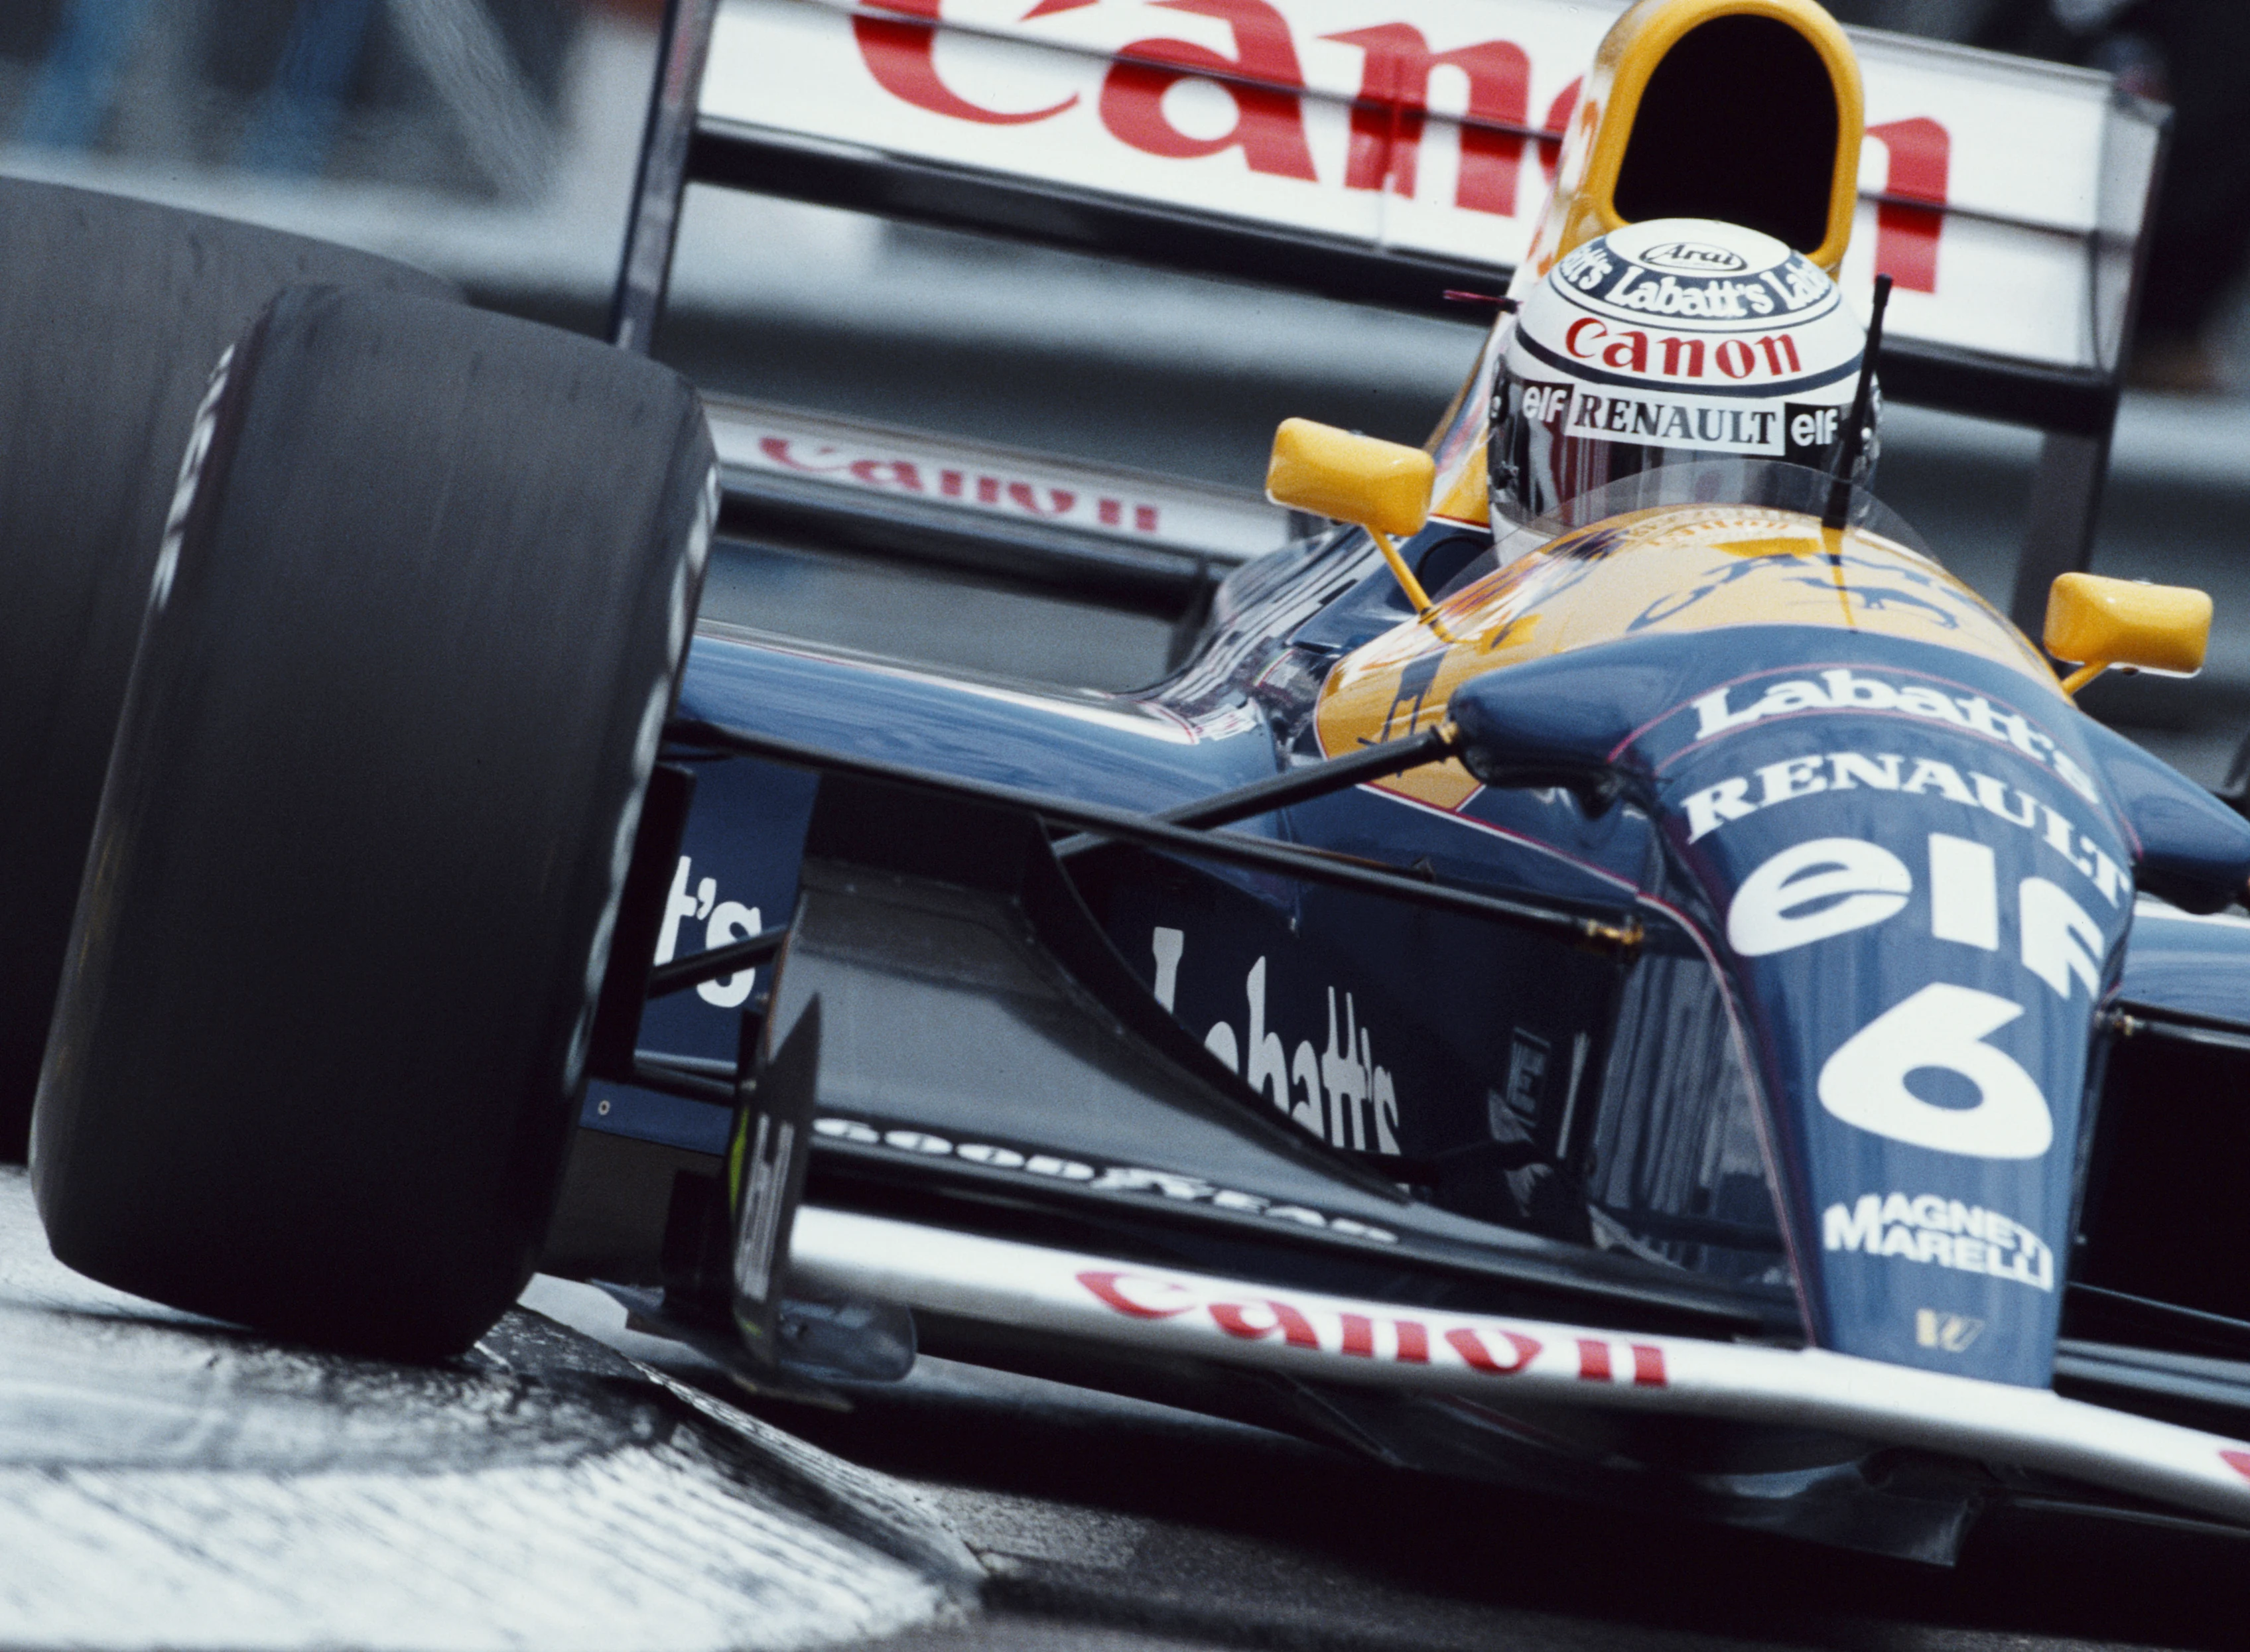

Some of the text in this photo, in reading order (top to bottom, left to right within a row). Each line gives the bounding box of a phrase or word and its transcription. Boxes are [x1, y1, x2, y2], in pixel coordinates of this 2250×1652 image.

[850, 0, 1950, 294] Cann
[1605, 265, 1774, 320] Labatt's
[1646, 243, 1733, 266] Arai
[1565, 317, 1802, 379] Canon
[1522, 385, 1567, 423] elf
[1573, 393, 1778, 444] RENAULT
[1791, 408, 1839, 447] elf
[758, 435, 1159, 533] Canon
[1680, 751, 2131, 909] RENAULT
[1728, 831, 2105, 1000] elf
[1818, 982, 2053, 1159] 6
[1074, 1271, 1668, 1387] Canon
